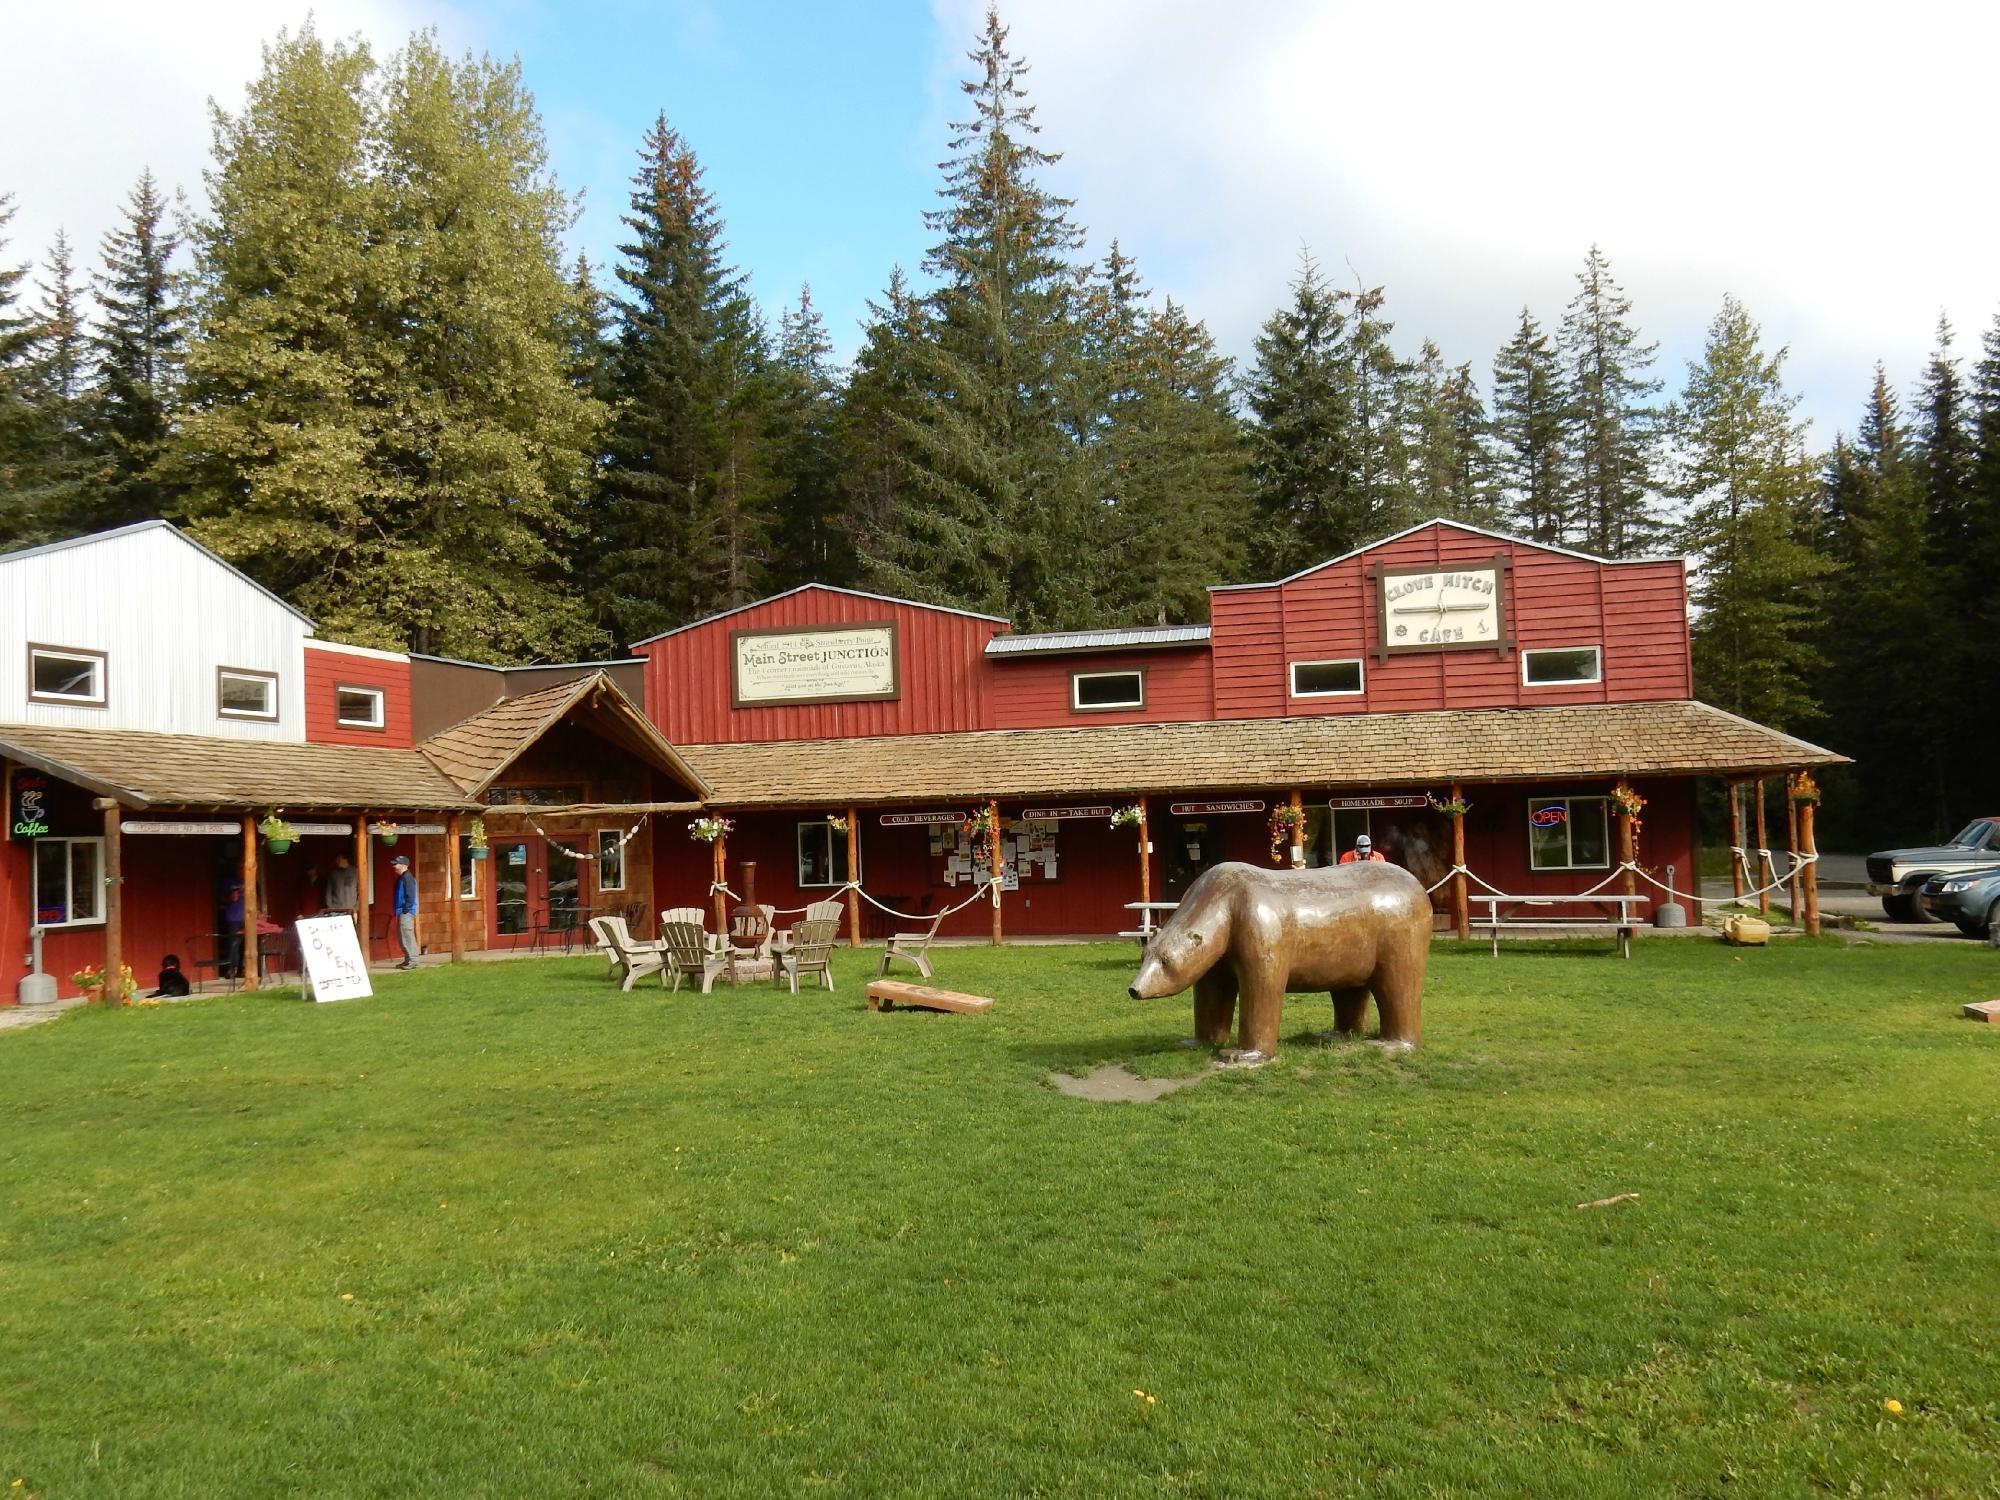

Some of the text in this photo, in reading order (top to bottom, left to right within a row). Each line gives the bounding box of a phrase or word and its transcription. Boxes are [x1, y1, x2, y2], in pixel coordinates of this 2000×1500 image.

[1385, 574, 1495, 602] CLOVE HITCH
[742, 646, 889, 668] Main Street JUNCTION
[1206, 802, 1255, 812] SANDWICHES
[1341, 798, 1413, 807] HOMEMADE SOUP
[892, 813, 955, 823] COLD BEVERAGES
[1069, 809, 1089, 817] TAKE
[1091, 808, 1106, 816] OUT
[1532, 811, 1568, 823] OPEN
[14, 822, 49, 836] Coffee
[312, 938, 356, 974] OPEN
